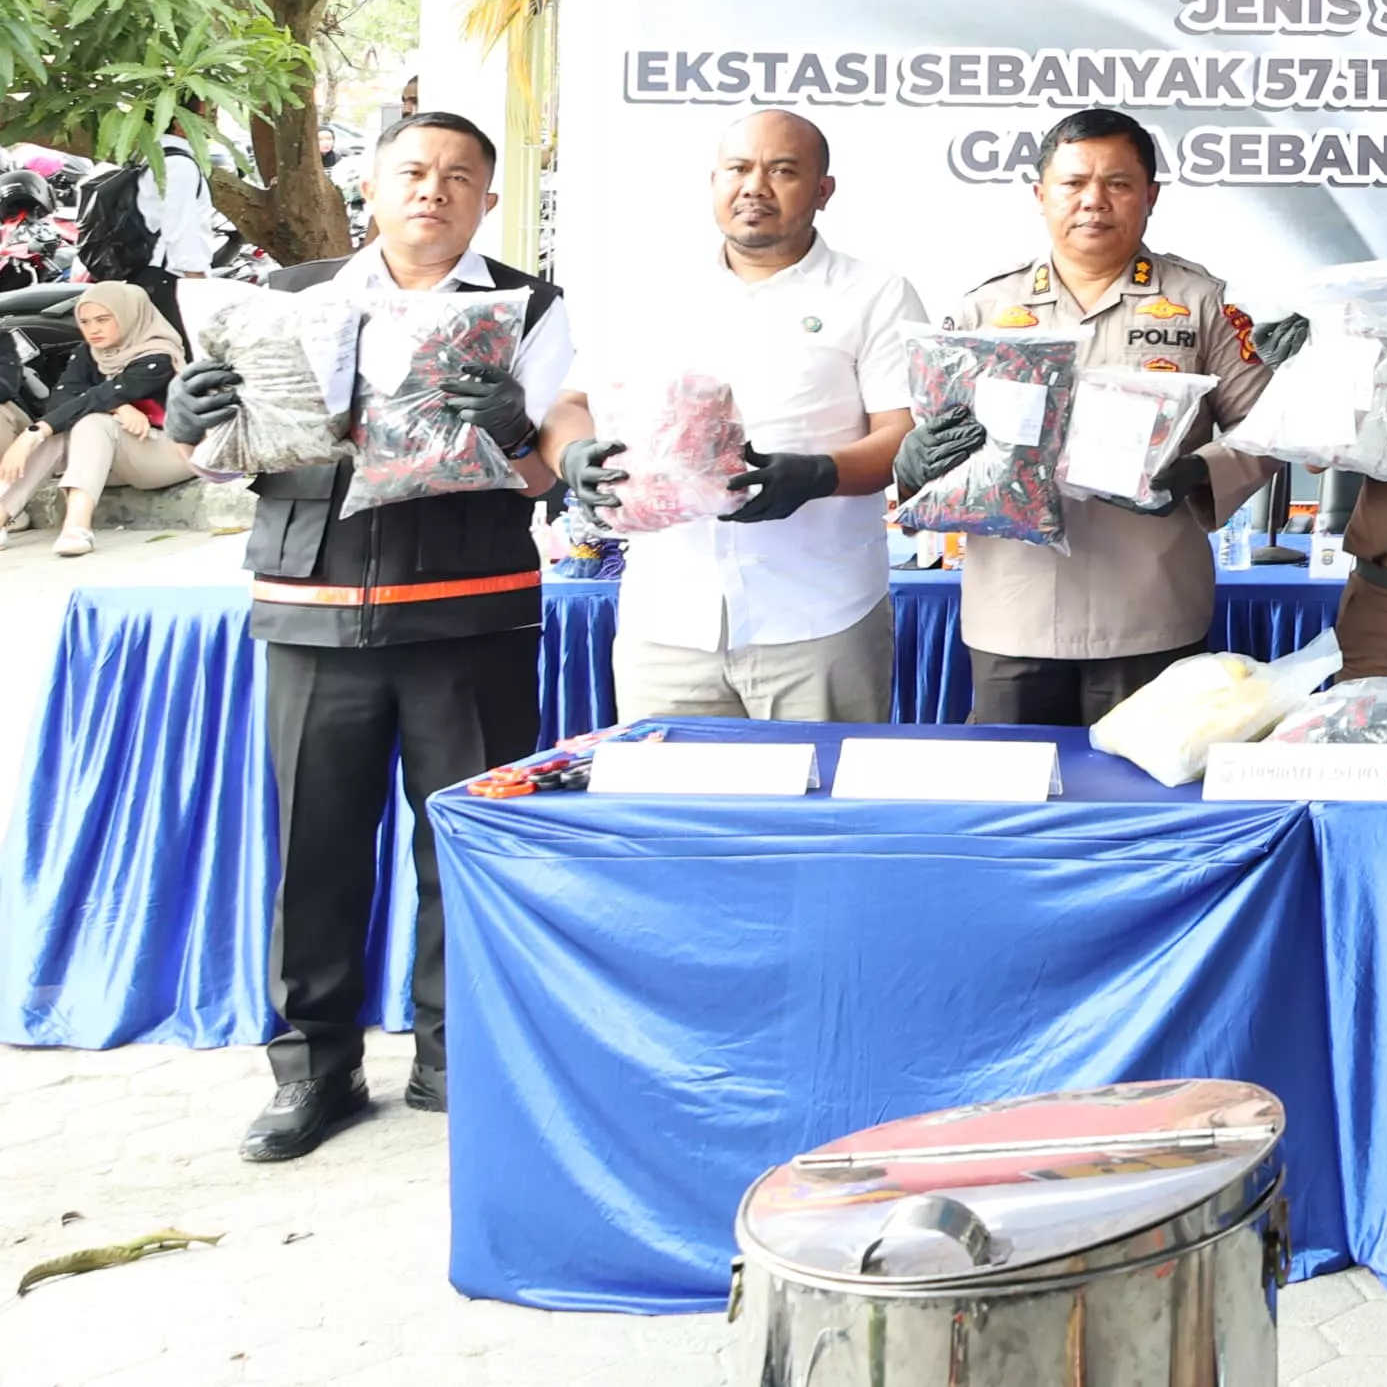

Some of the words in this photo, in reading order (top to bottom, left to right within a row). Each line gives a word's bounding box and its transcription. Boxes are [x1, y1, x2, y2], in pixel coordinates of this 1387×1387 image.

[637, 50, 888, 94] EKSTASI
[910, 53, 1243, 100] SEBANYAK
[1128, 329, 1197, 348] POLRI
